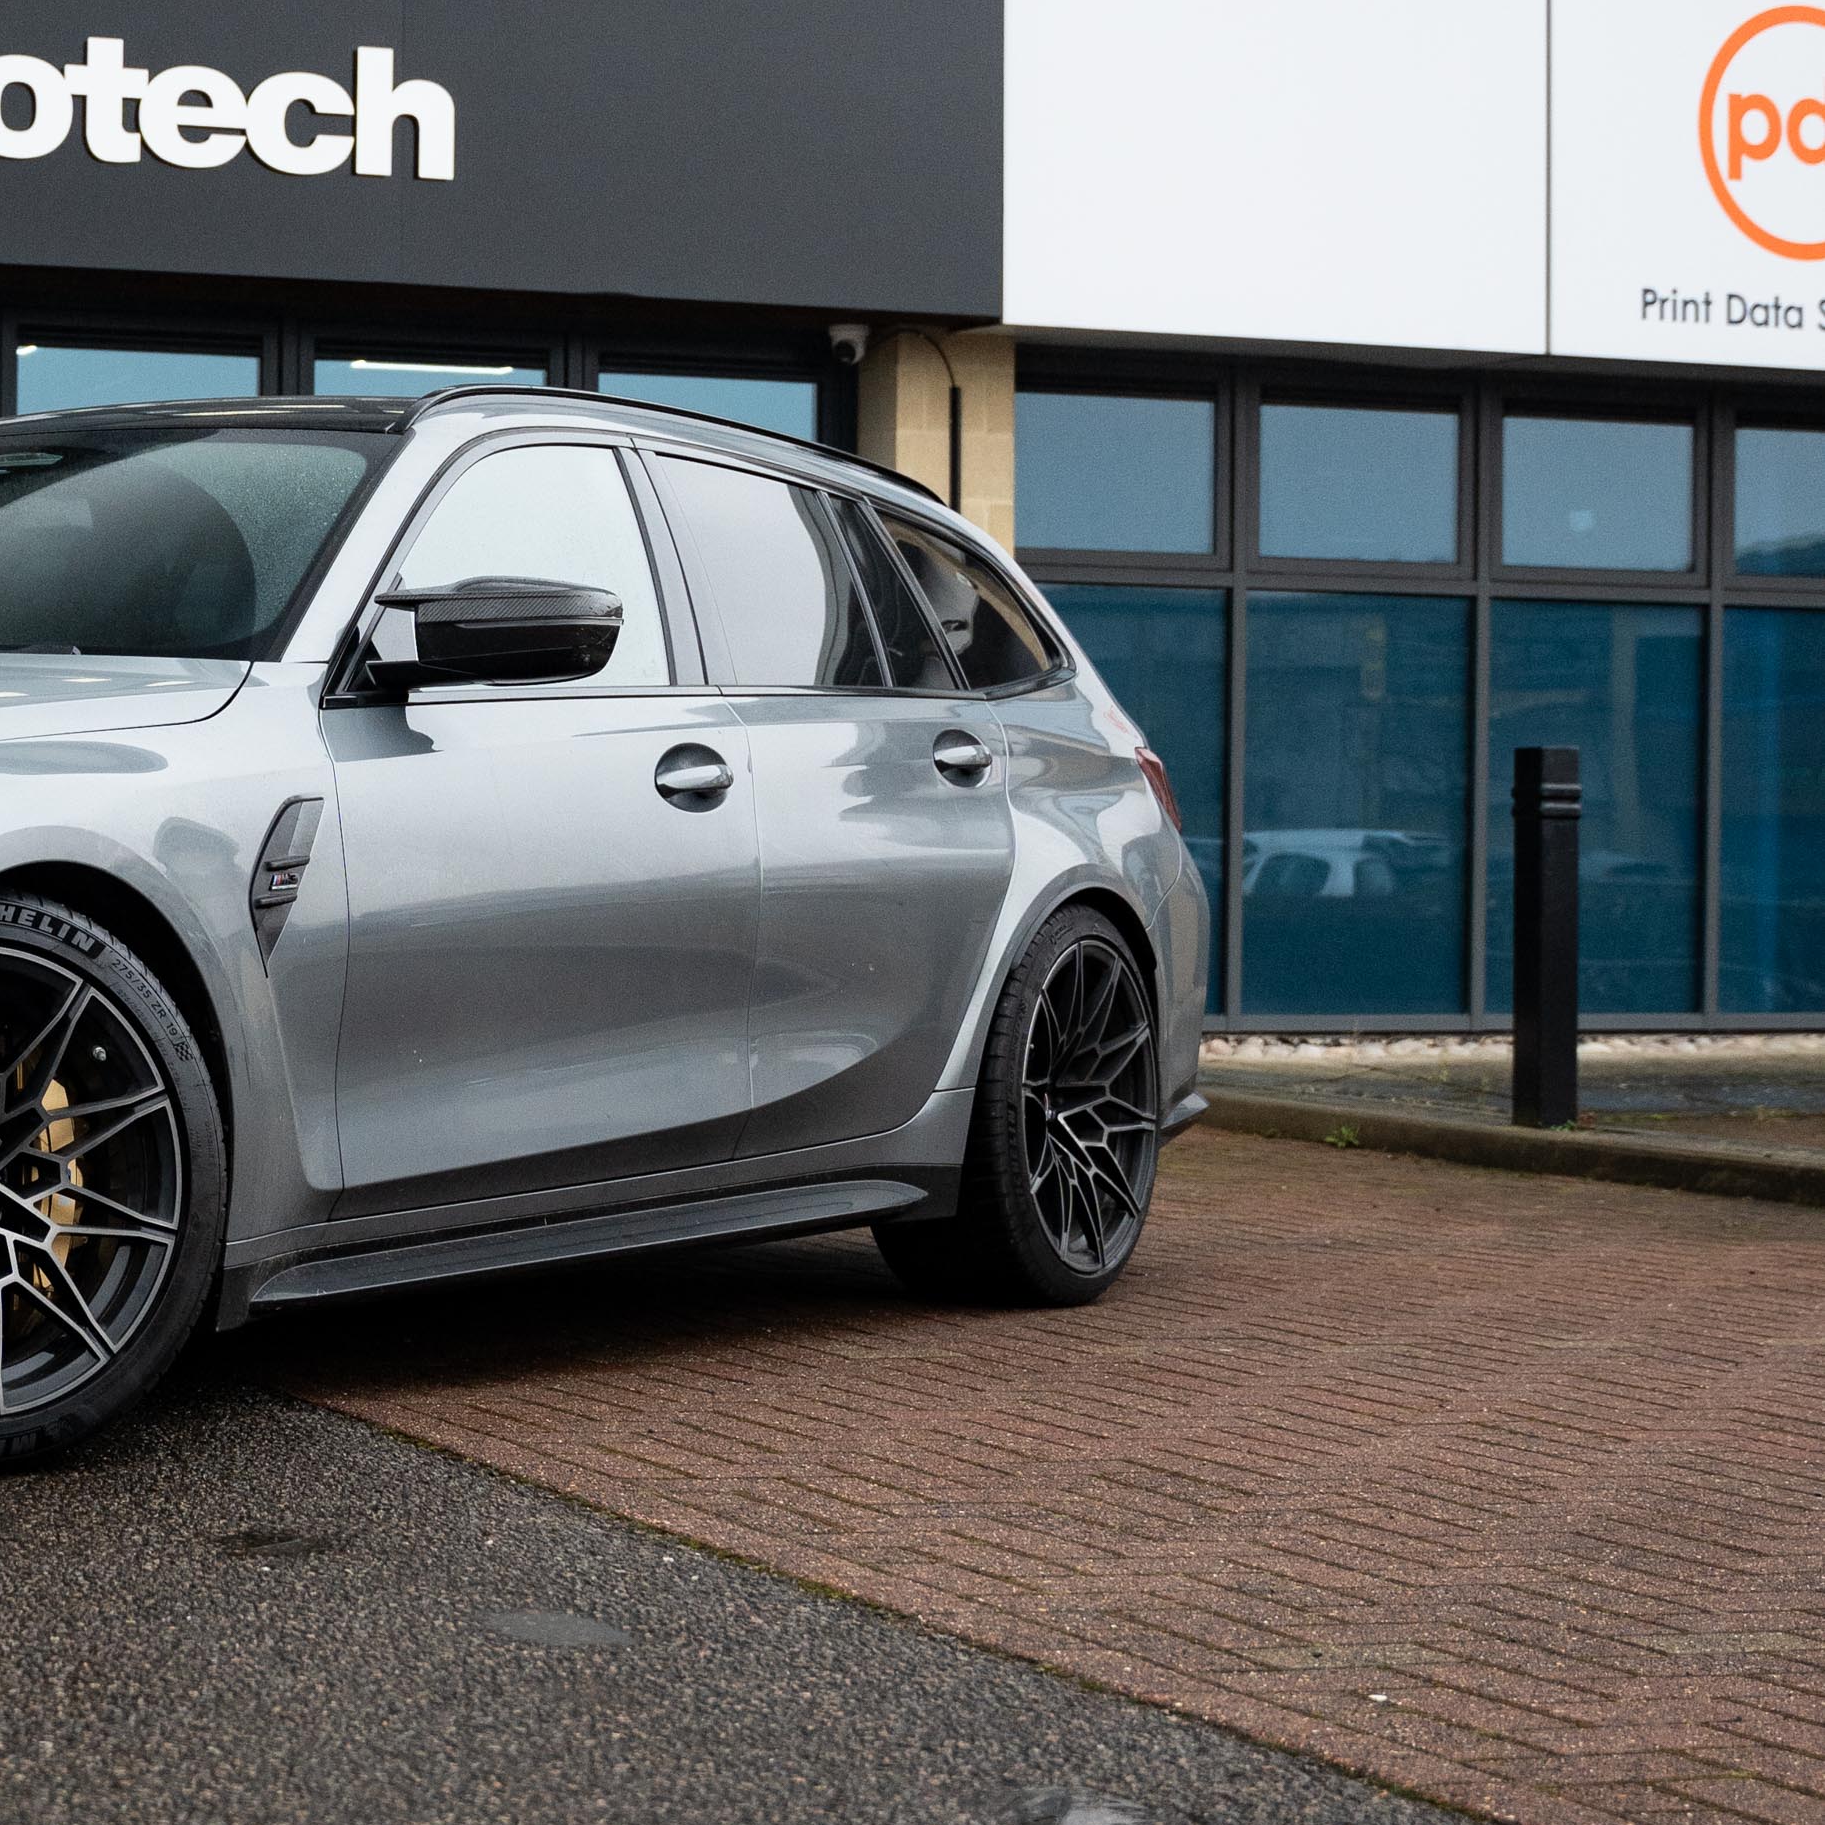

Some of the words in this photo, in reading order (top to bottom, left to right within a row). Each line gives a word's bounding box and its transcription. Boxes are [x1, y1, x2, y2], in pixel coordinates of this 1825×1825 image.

[1641, 287, 1713, 324] Print
[1726, 292, 1803, 330] Data
[112, 958, 152, 999] 275/35
[151, 1000, 167, 1019] ZR
[166, 1023, 178, 1036] 19
